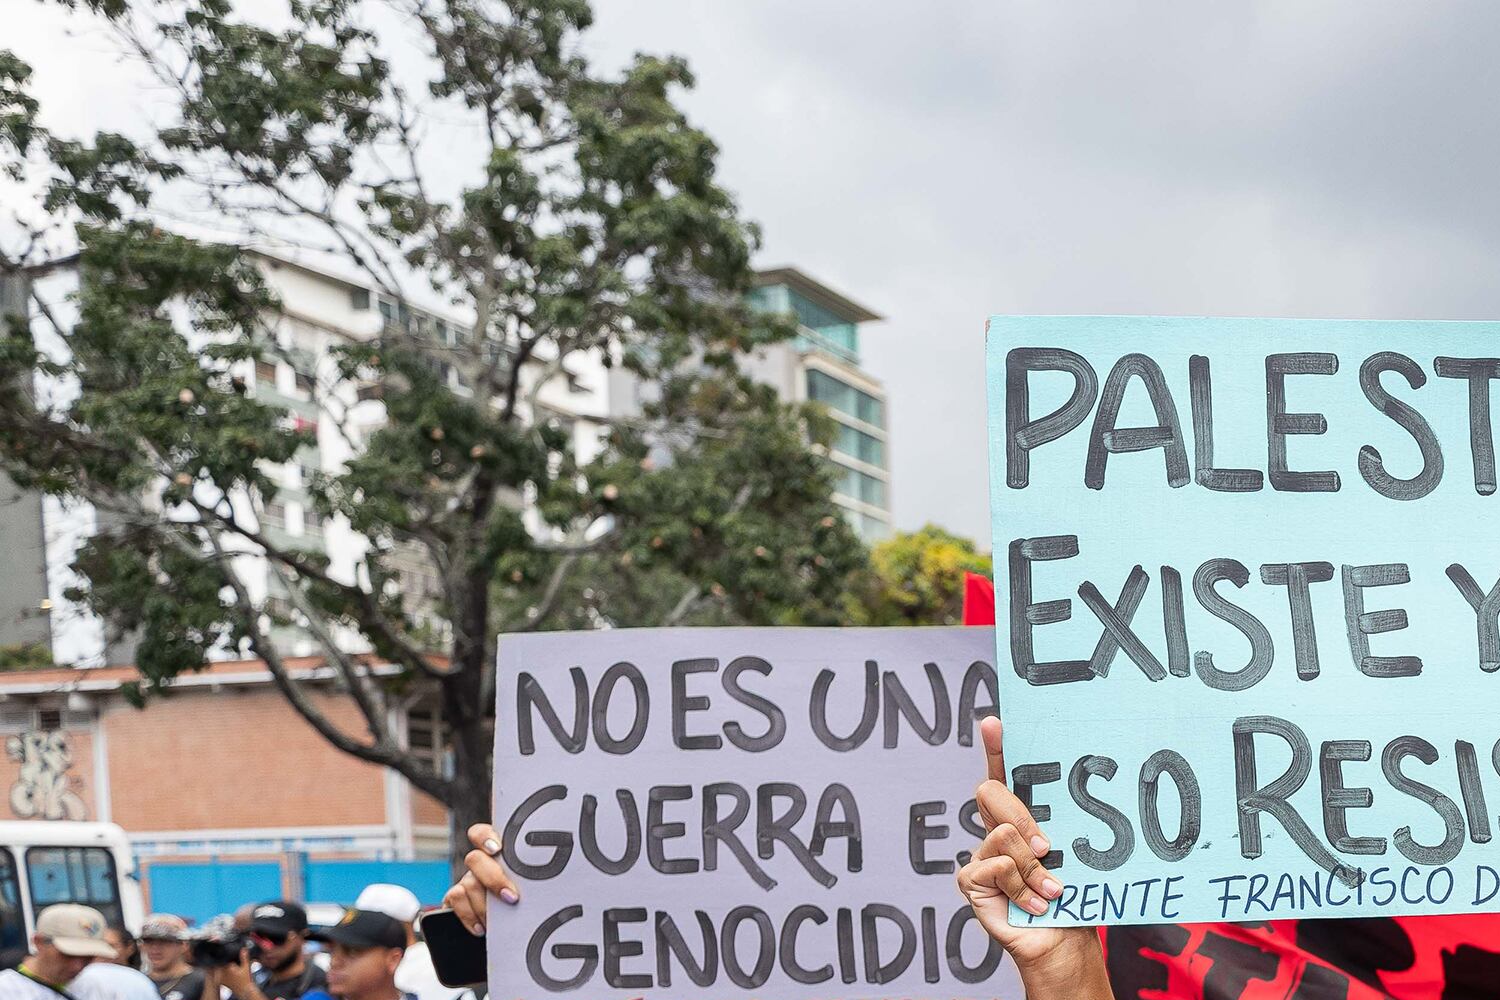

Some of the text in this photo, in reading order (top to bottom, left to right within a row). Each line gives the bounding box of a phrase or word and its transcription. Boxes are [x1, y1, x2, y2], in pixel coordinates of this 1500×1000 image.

[1009, 534, 1422, 691] EXISTE
[517, 655, 1001, 755] NO ES UNA
[502, 782, 988, 892] GUERRA ES
[1012, 749, 1201, 871] ESO
[1028, 874, 1185, 924] RENTE
[1209, 866, 1455, 918] FRANCISCO
[526, 904, 1005, 992] GENOCIDIO
